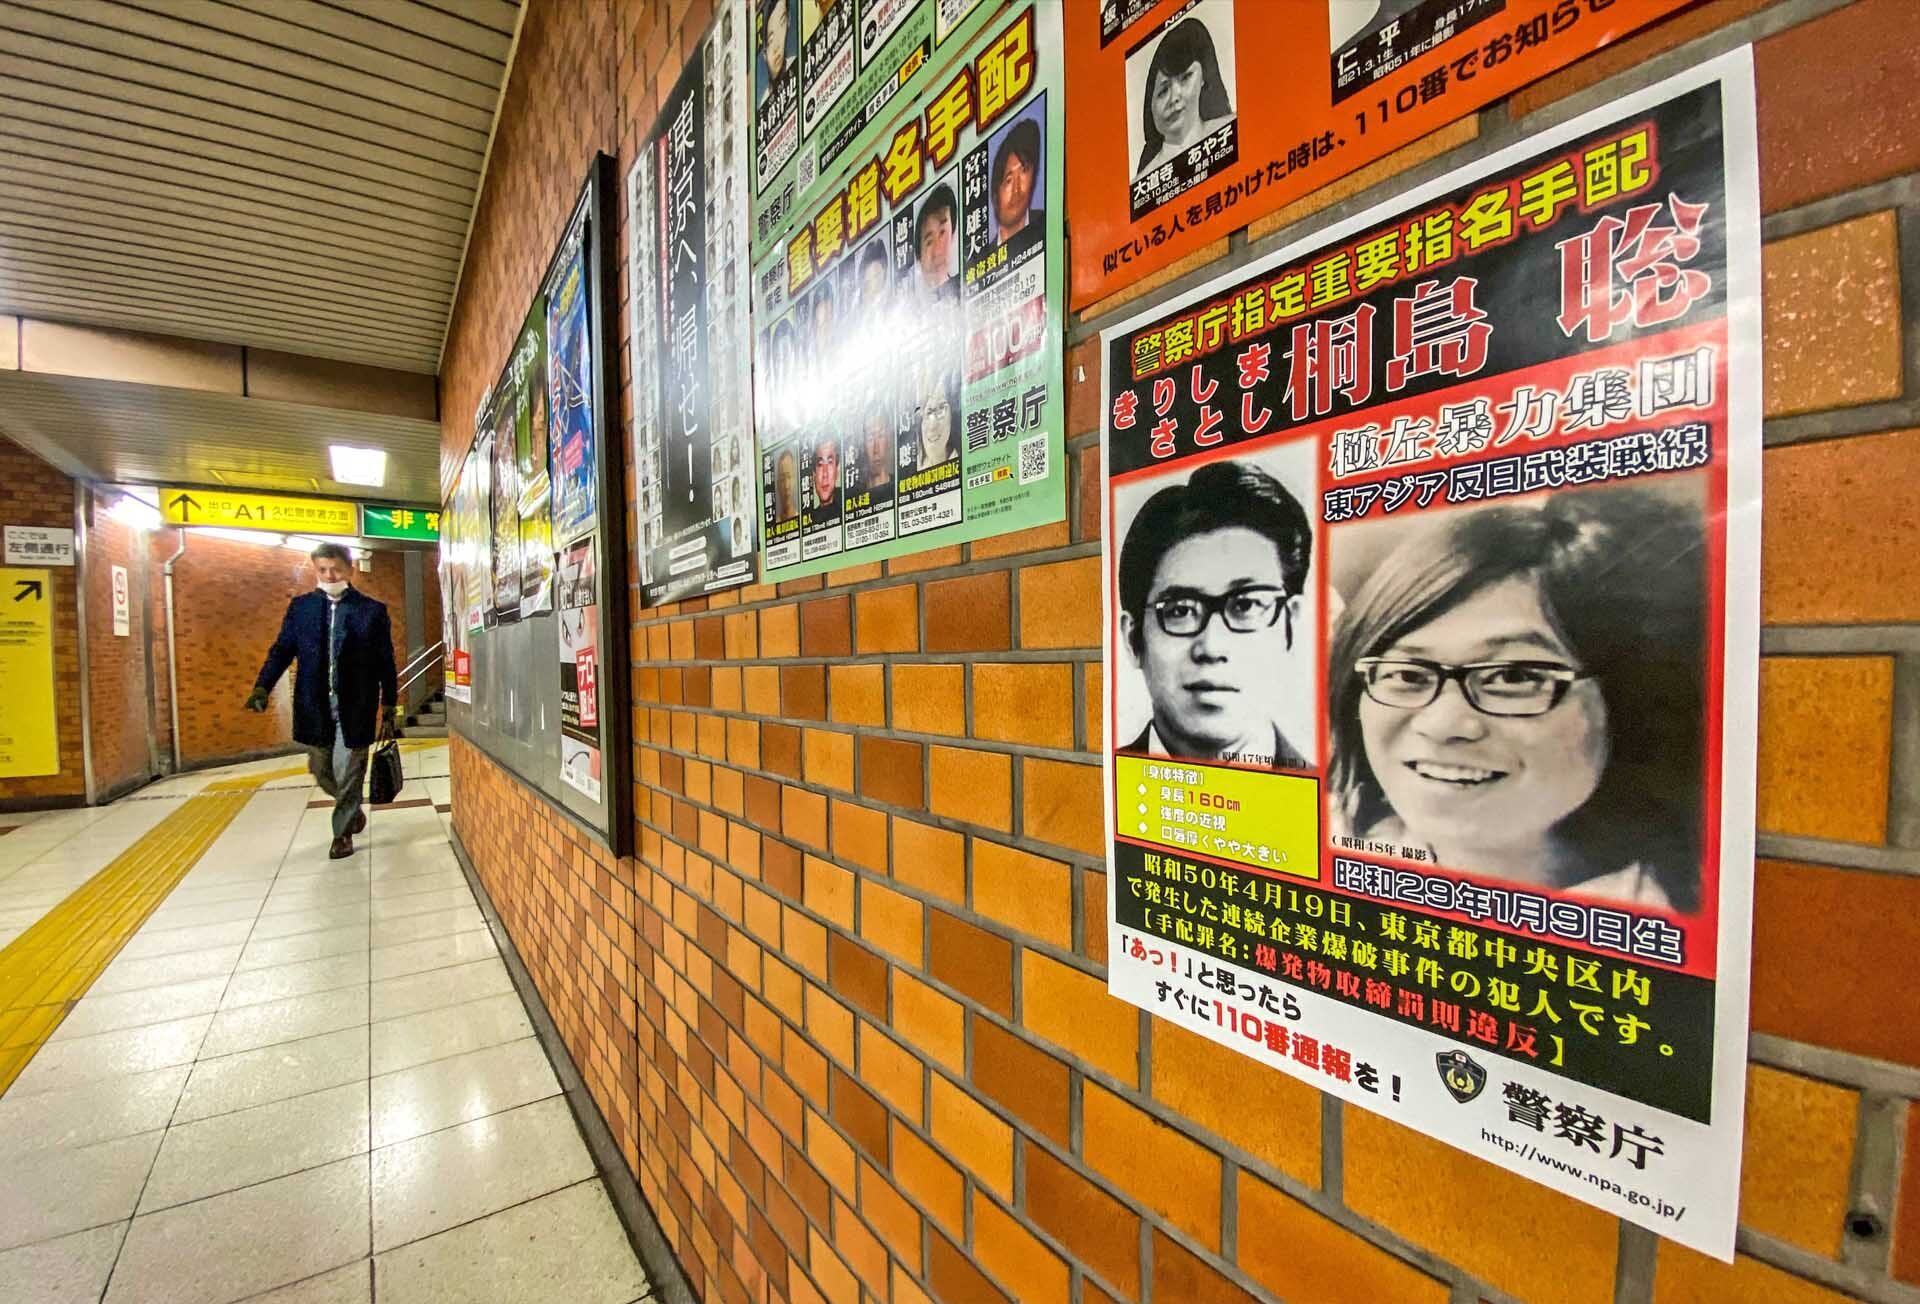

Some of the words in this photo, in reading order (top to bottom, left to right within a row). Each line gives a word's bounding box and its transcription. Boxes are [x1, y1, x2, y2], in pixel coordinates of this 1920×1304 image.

[788, 13, 1033, 295] 重要指名手配
[1133, 162, 1174, 201] 大道寺
[1187, 124, 1233, 166] あや子
[1134, 129, 1651, 377] 警察庁指定重要指名手配
[1282, 275, 1497, 421] 桐島
[1555, 192, 1711, 344] 聡
[965, 384, 1049, 453] 警察庁
[1113, 343, 1271, 431] きりしま
[1150, 391, 1273, 459] さとし
[1330, 346, 1713, 477] 極左暴力集団
[234, 503, 266, 521] A1
[1323, 424, 1711, 521] 東アジア反日武装戦線
[1143, 852, 1652, 1006] 昭和50年4月19日、東京都中央区内
[1333, 857, 1684, 964] 昭和29年1月9日生
[1126, 876, 1675, 1057] で発生した連続企業爆破事件の犯人です。
[1154, 980, 1402, 1102] すぐに110番通報を！
[1481, 1127, 1686, 1222] http://www.npa.go.jp/
[1502, 1081, 1665, 1170] 警察庁
